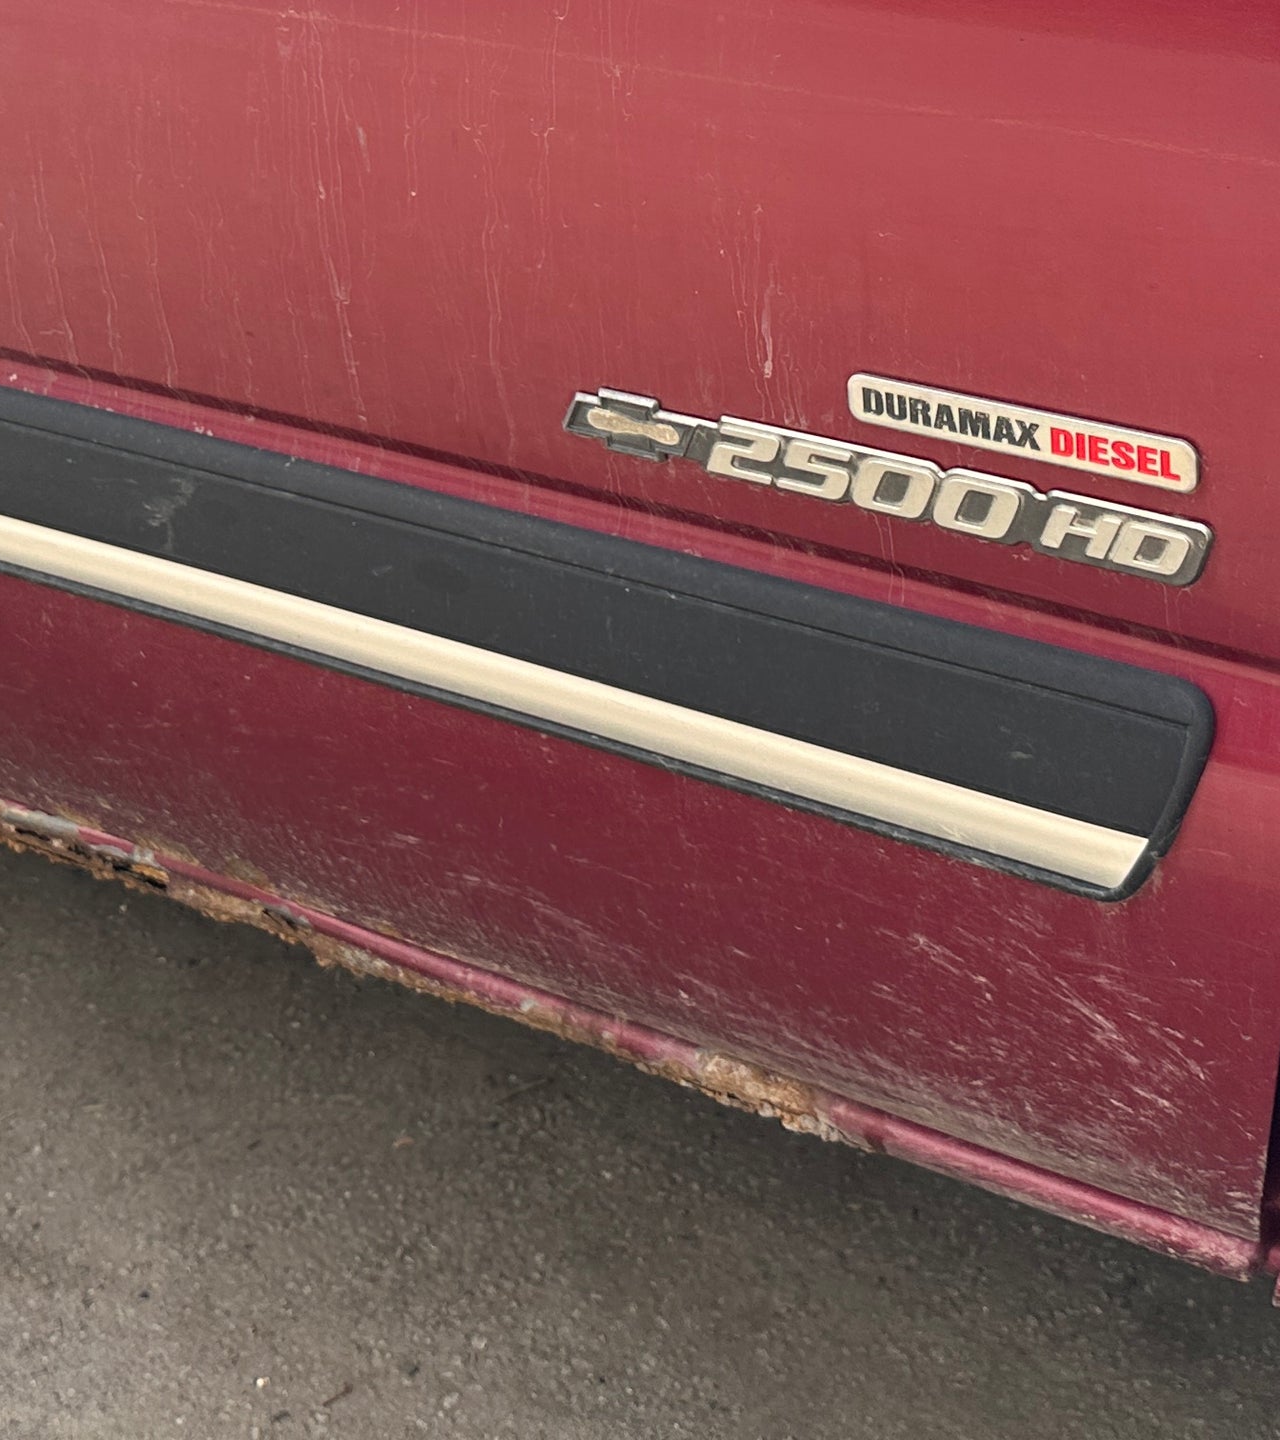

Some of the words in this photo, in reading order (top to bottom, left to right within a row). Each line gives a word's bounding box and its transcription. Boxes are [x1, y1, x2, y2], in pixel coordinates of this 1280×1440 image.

[862, 387, 1041, 452] DURAMAX
[1050, 426, 1181, 482] DIESEL
[707, 422, 1022, 540] 2500
[1039, 504, 1190, 576] HD
